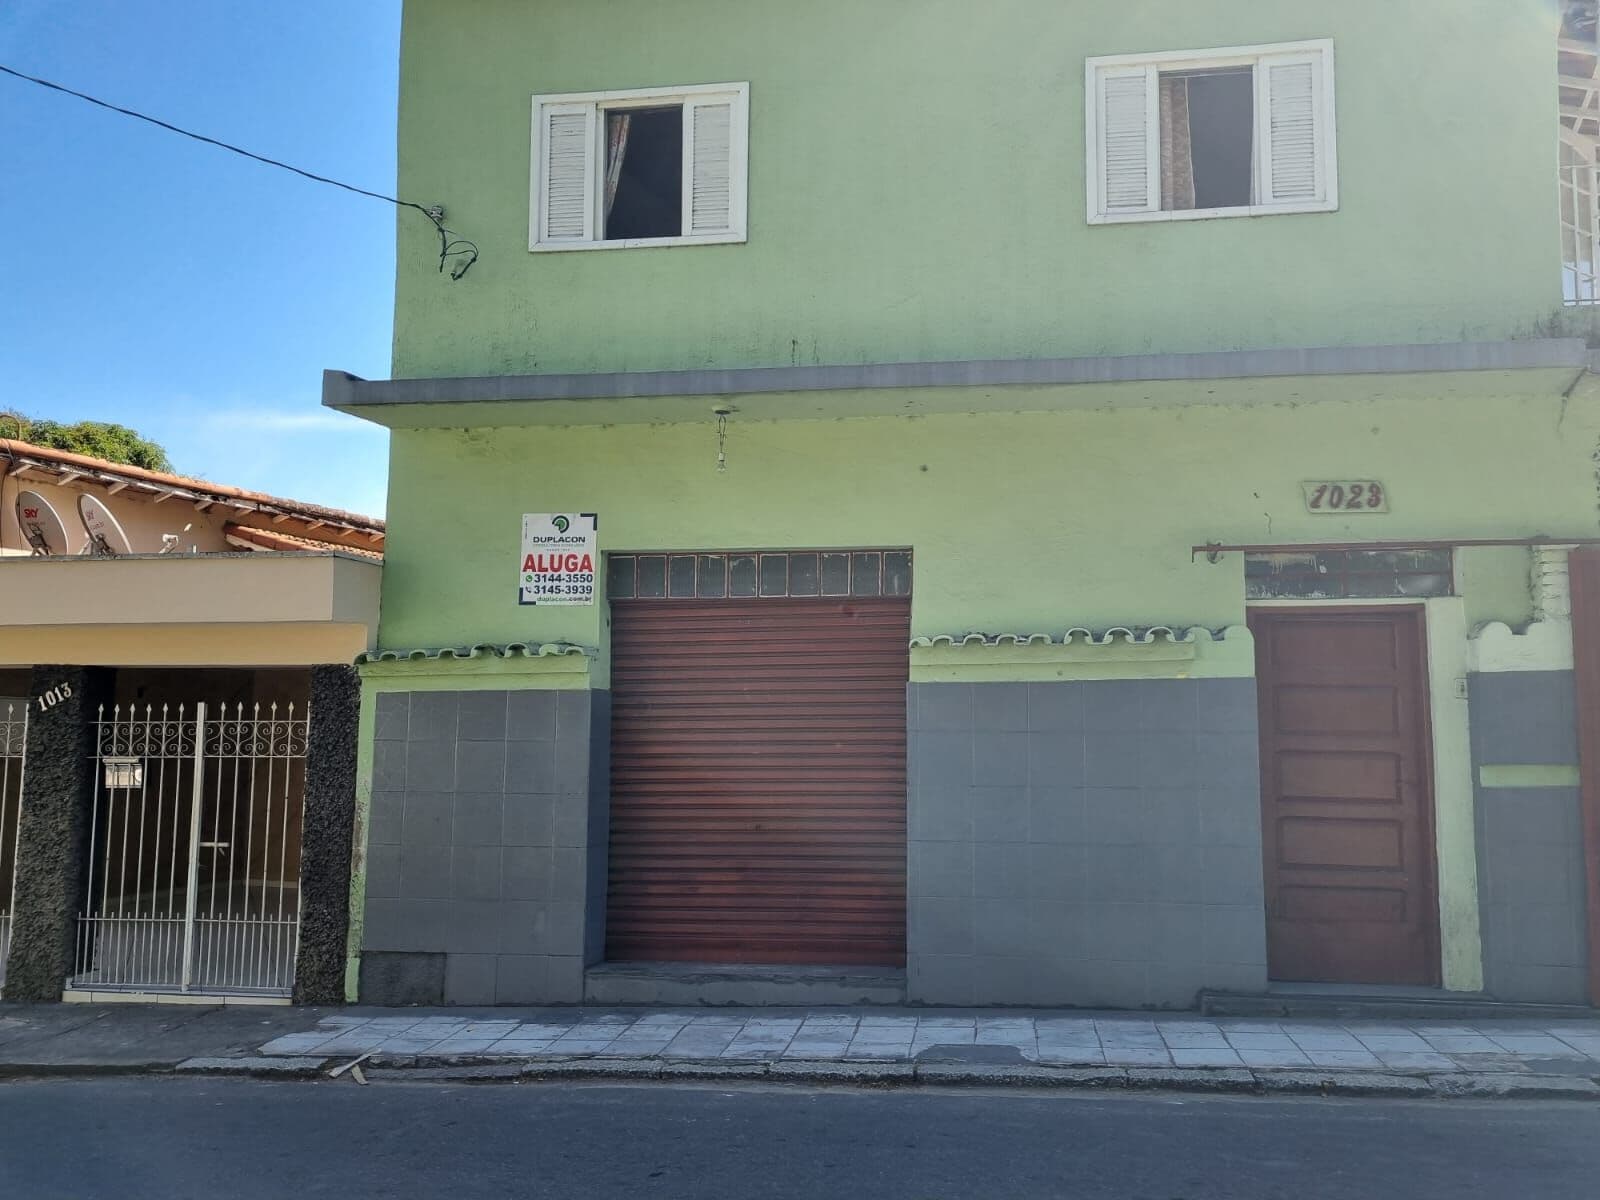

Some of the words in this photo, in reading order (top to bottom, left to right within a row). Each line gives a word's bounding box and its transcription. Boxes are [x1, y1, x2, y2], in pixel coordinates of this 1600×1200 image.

[1309, 483, 1381, 509] 1023
[522, 553, 593, 573] ALUGA
[534, 574, 593, 583] 3144-3550
[534, 585, 593, 594] 3145-3939
[38, 682, 72, 712] 1013
